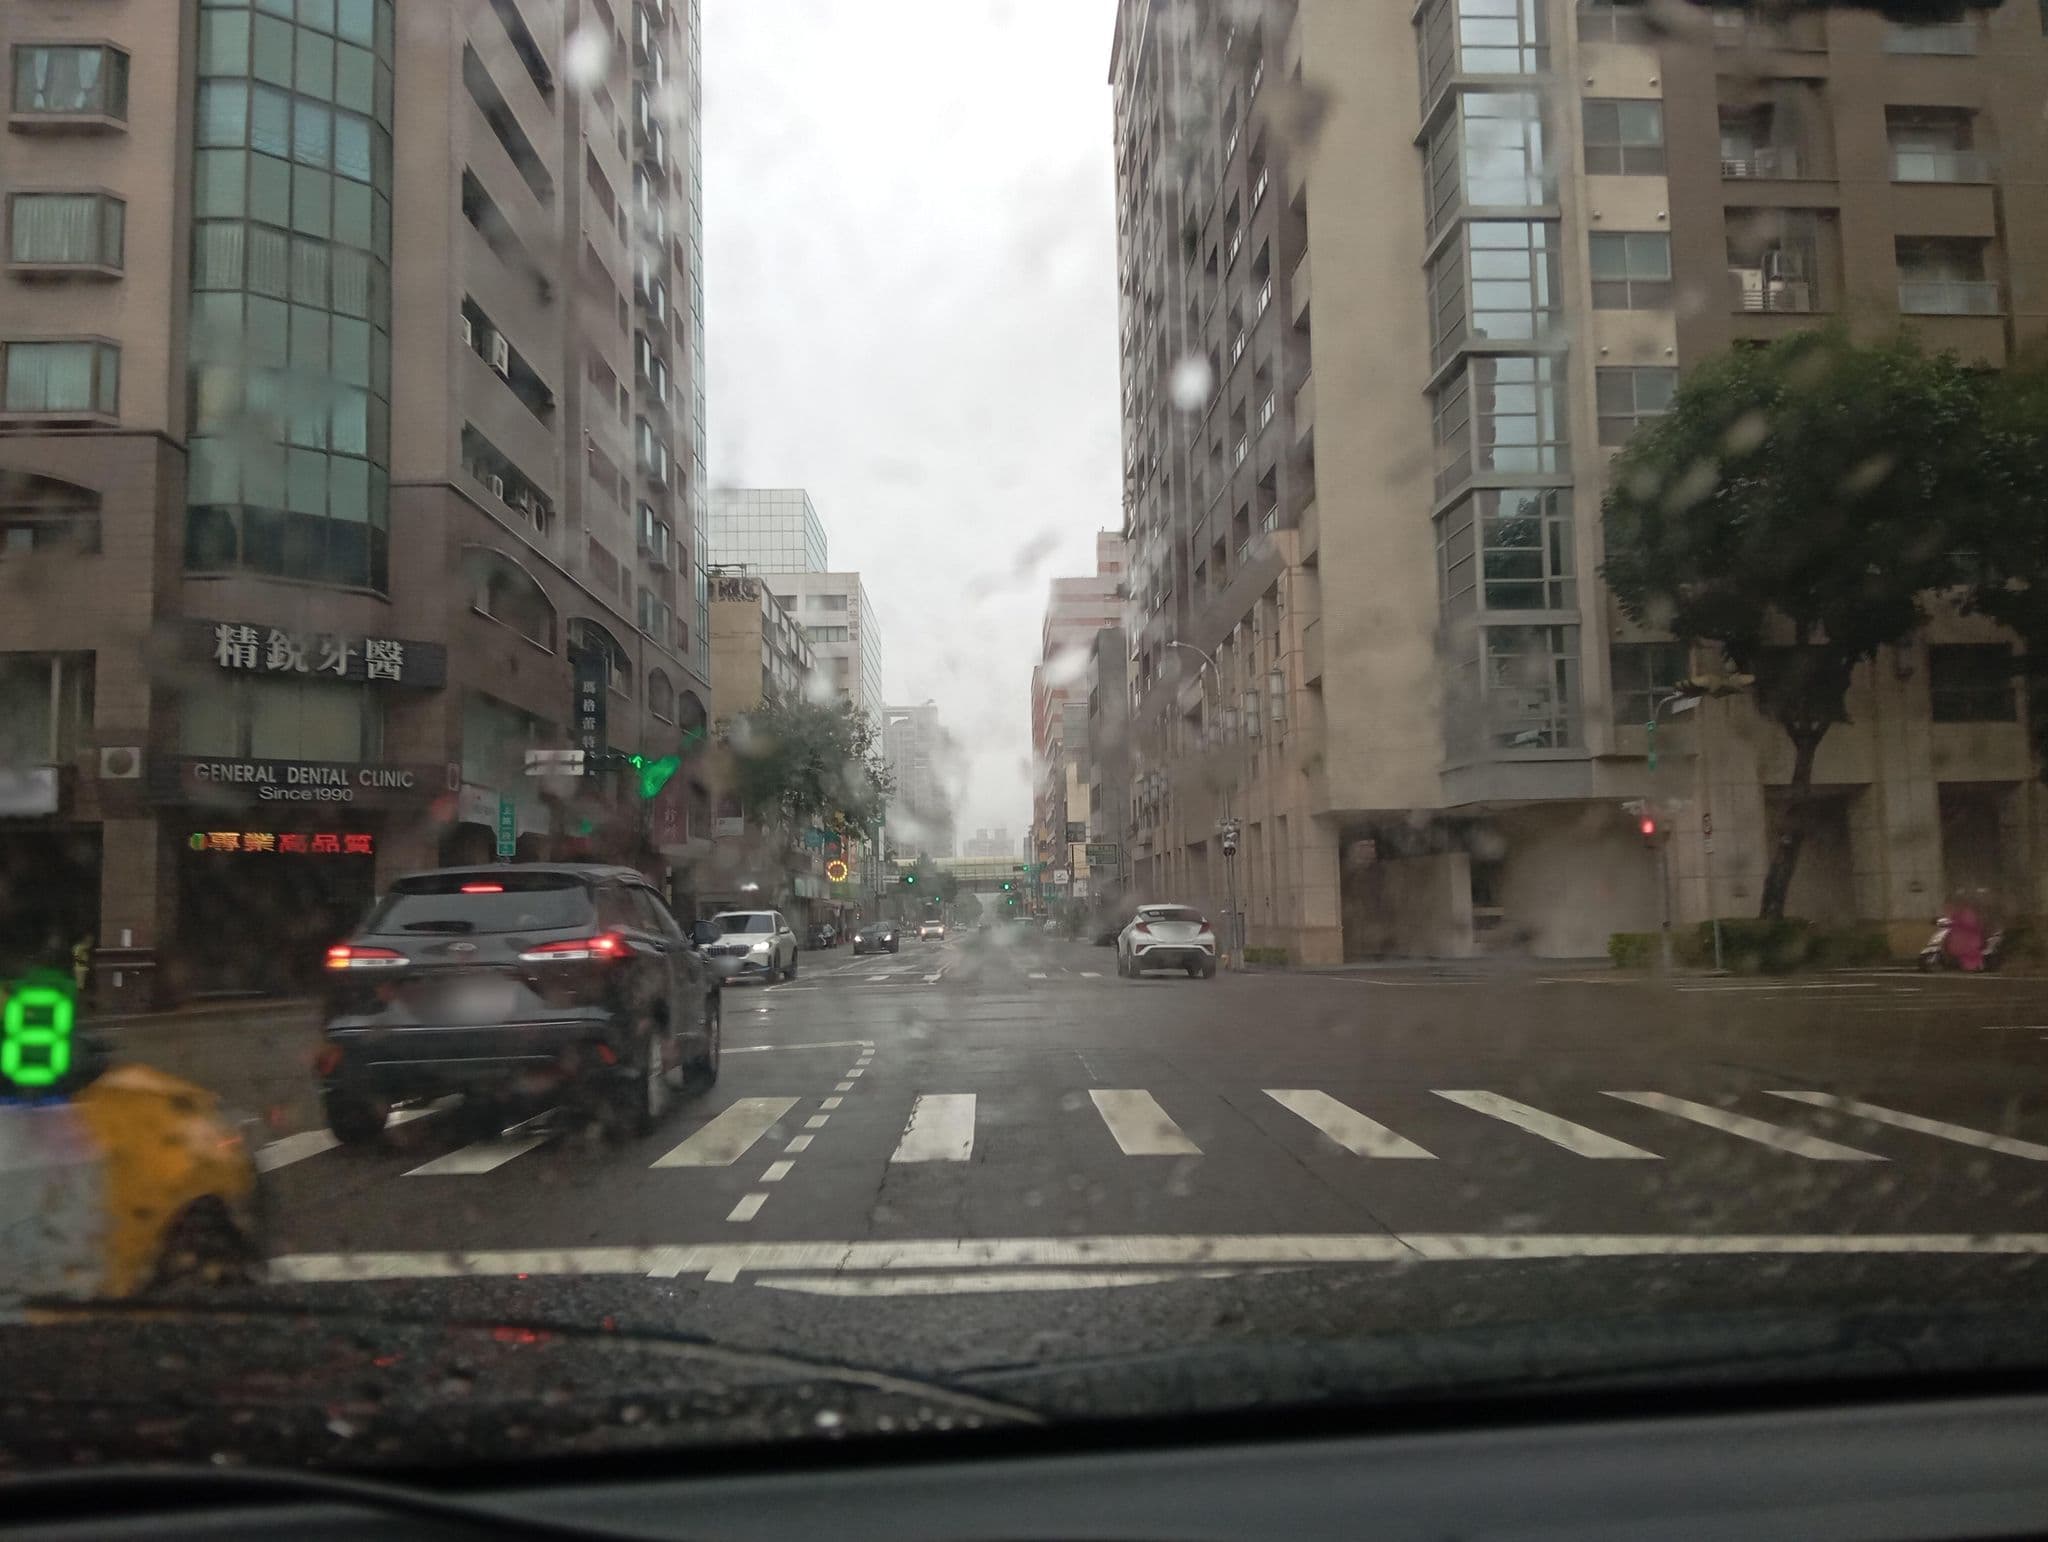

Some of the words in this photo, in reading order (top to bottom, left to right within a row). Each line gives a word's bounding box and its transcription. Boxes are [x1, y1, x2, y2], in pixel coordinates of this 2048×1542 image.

[213, 623, 404, 681] 精銳牙醫
[194, 763, 277, 784] GENERAL
[287, 767, 350, 786] DENTAL
[359, 769, 415, 788] CLINIC
[259, 786, 312, 801] Since
[315, 788, 354, 801] 1990
[207, 832, 374, 854] 專業高品質
[1, 988, 73, 1085] 8
